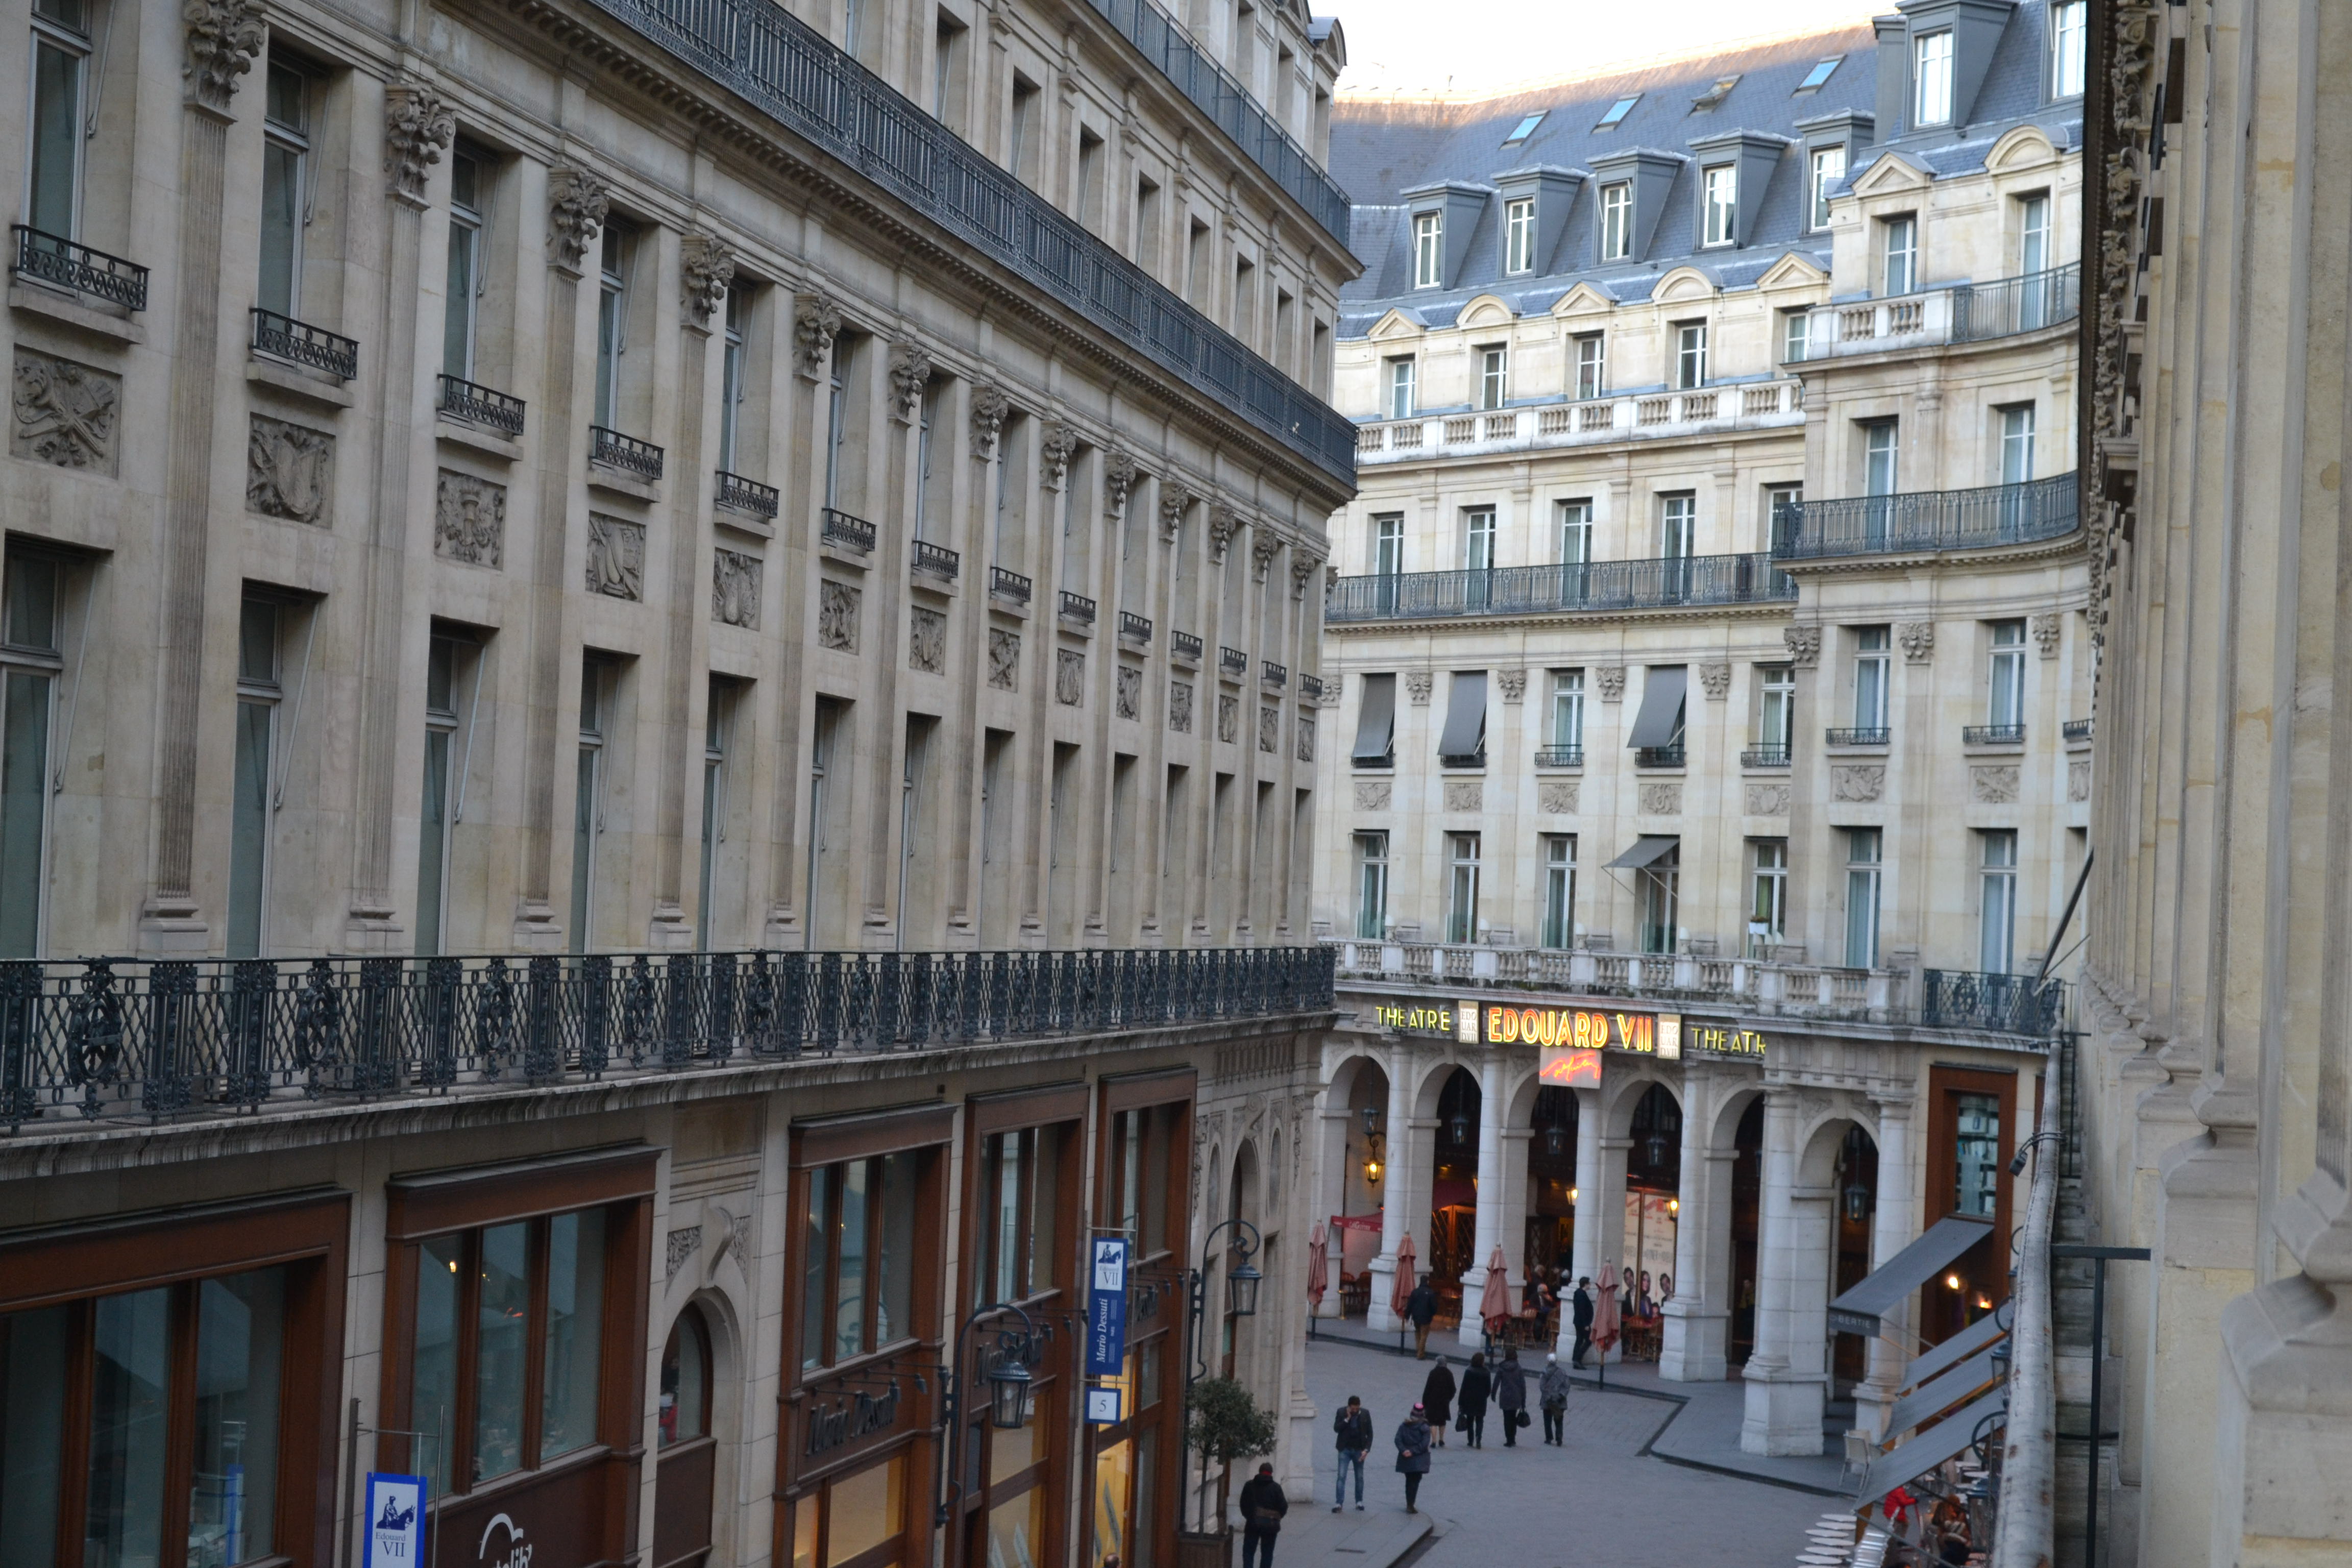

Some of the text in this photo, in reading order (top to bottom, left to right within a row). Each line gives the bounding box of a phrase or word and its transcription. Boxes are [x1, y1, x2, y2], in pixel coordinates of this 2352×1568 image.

[1376, 1007, 1451, 1031] THEATRE
[1488, 1007, 1652, 1052] EDOUARD VII
[1104, 1271, 1118, 1286] VII
[1096, 1297, 1108, 1363] Mario Dessuti
[1099, 1399, 1107, 1412] 5
[376, 1532, 406, 1541] Edouard
[383, 1541, 405, 1557] VII
